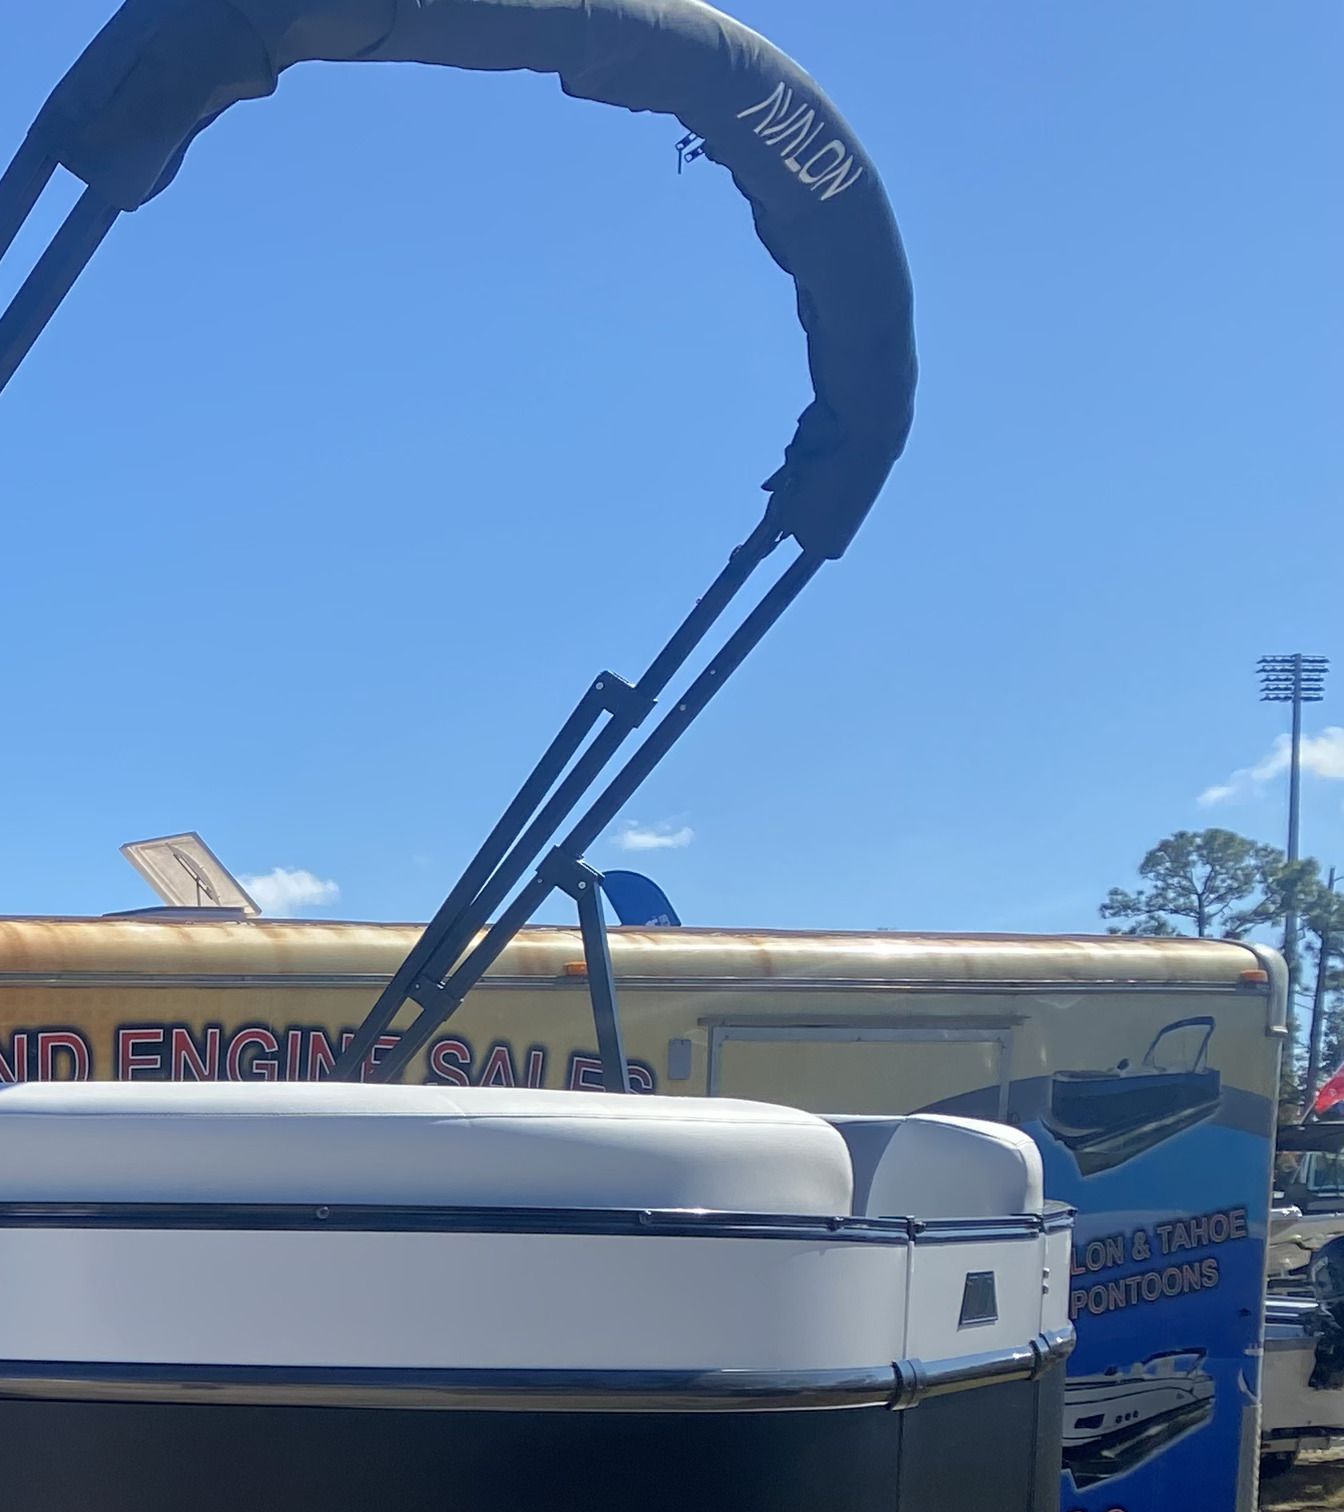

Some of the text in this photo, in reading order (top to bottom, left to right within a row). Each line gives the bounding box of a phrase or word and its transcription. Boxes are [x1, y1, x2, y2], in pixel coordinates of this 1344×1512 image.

[736, 81, 864, 201] AVALON
[1132, 1231, 1151, 1261] &
[1156, 1208, 1247, 1255] TAHOE
[1070, 1257, 1219, 1320] PONTOONS
